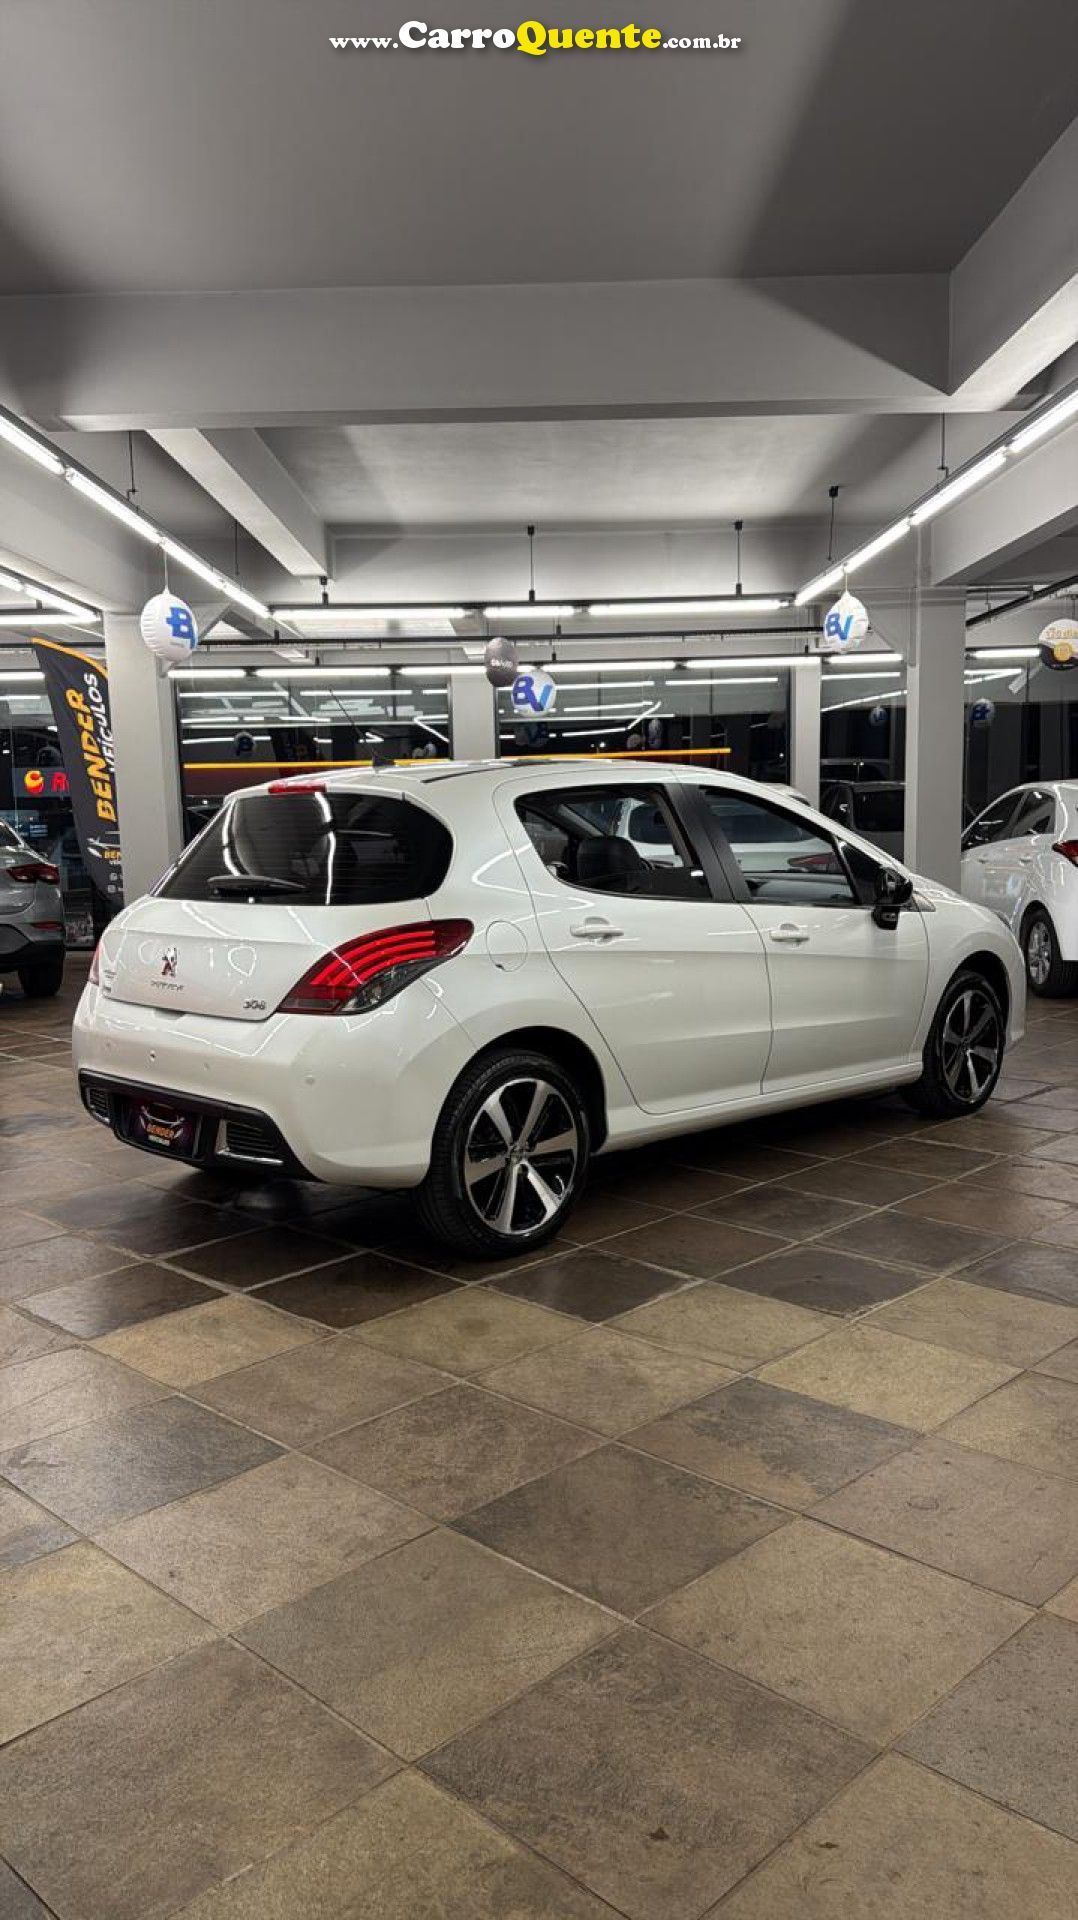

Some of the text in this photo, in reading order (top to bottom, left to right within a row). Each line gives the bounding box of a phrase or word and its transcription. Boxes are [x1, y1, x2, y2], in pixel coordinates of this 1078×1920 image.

[826, 613, 854, 640] BV
[513, 676, 553, 711] BV
[65, 688, 117, 823] BENDER
